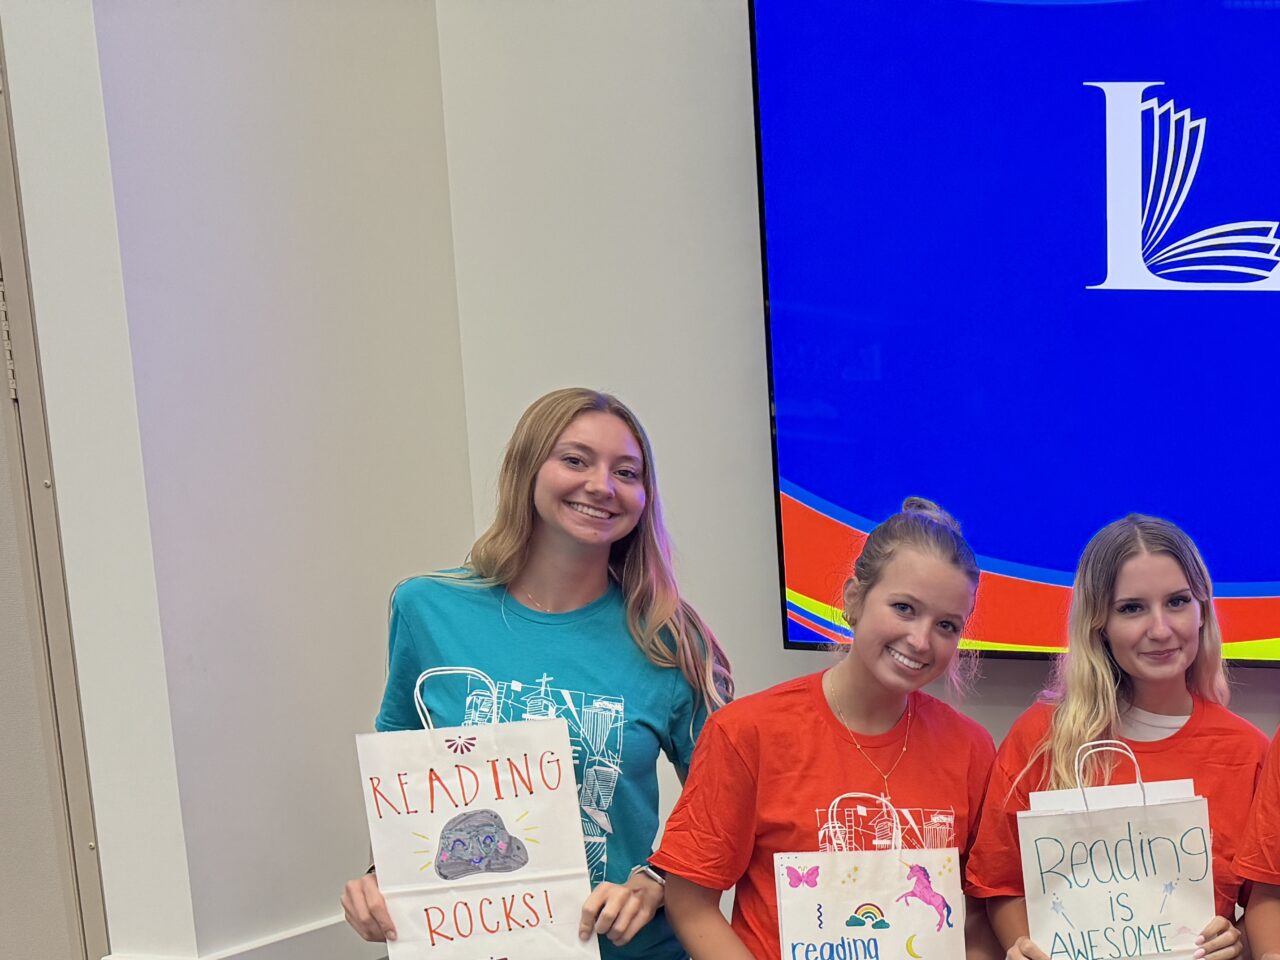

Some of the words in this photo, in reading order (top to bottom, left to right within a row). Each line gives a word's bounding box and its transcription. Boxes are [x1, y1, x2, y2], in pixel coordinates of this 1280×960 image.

[369, 750, 562, 818] READING
[1034, 822, 1209, 895] Reading
[424, 890, 554, 946] ROCKS!
